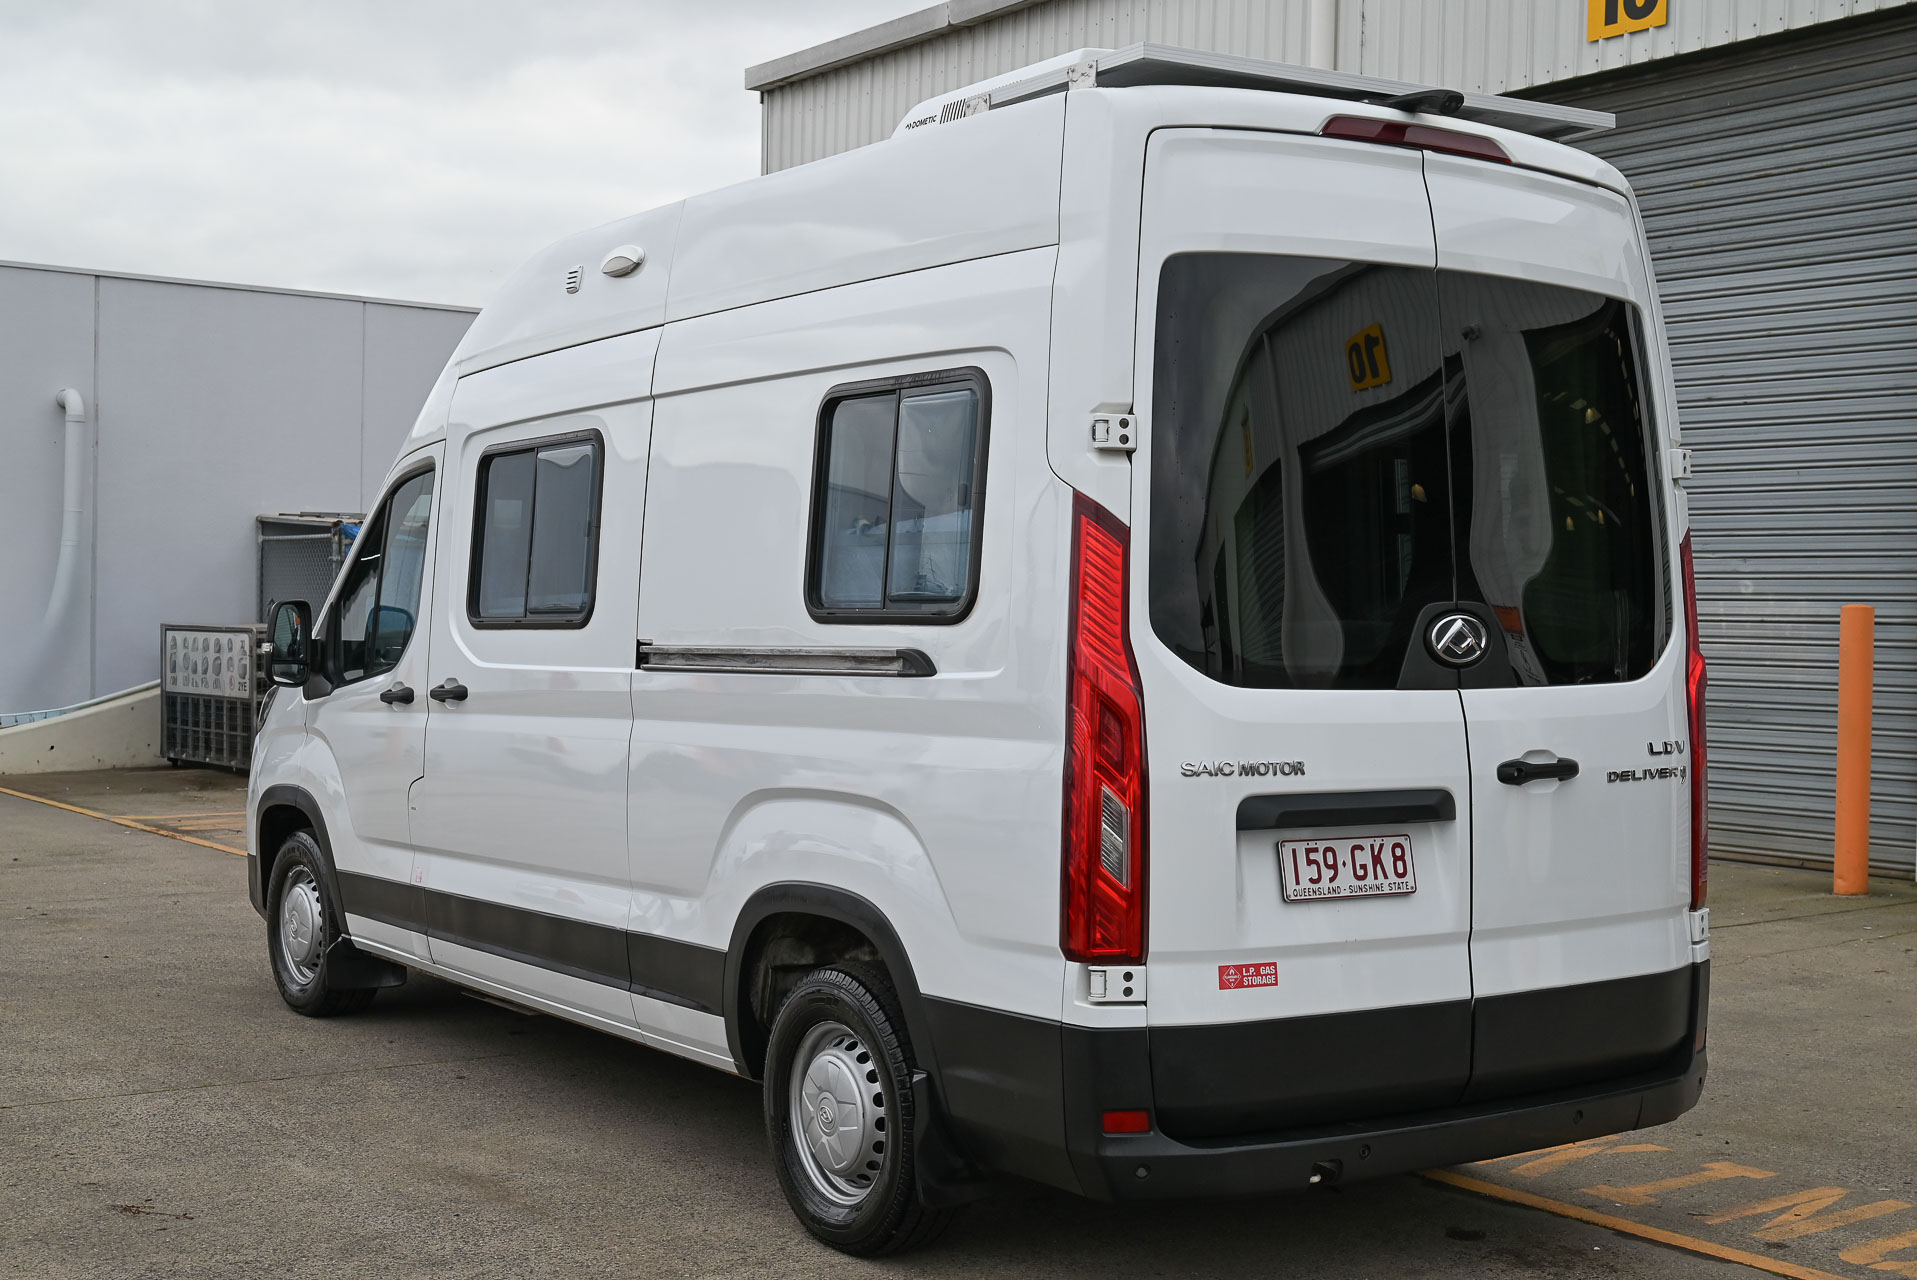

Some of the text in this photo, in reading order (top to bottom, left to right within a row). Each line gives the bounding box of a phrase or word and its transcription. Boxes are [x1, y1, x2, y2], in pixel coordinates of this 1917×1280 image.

[911, 114, 938, 129] DOMETIC
[1646, 740, 1685, 756] LDV
[1180, 759, 1306, 778] SAIC MOTOR
[1293, 885, 1342, 898] QUEENSLAND
[1349, 883, 1385, 894] SUNSHINE
[1388, 881, 1410, 892] STATE
[1242, 965, 1276, 976] L.P. GAS
[1243, 975, 1276, 986] STORAGE
